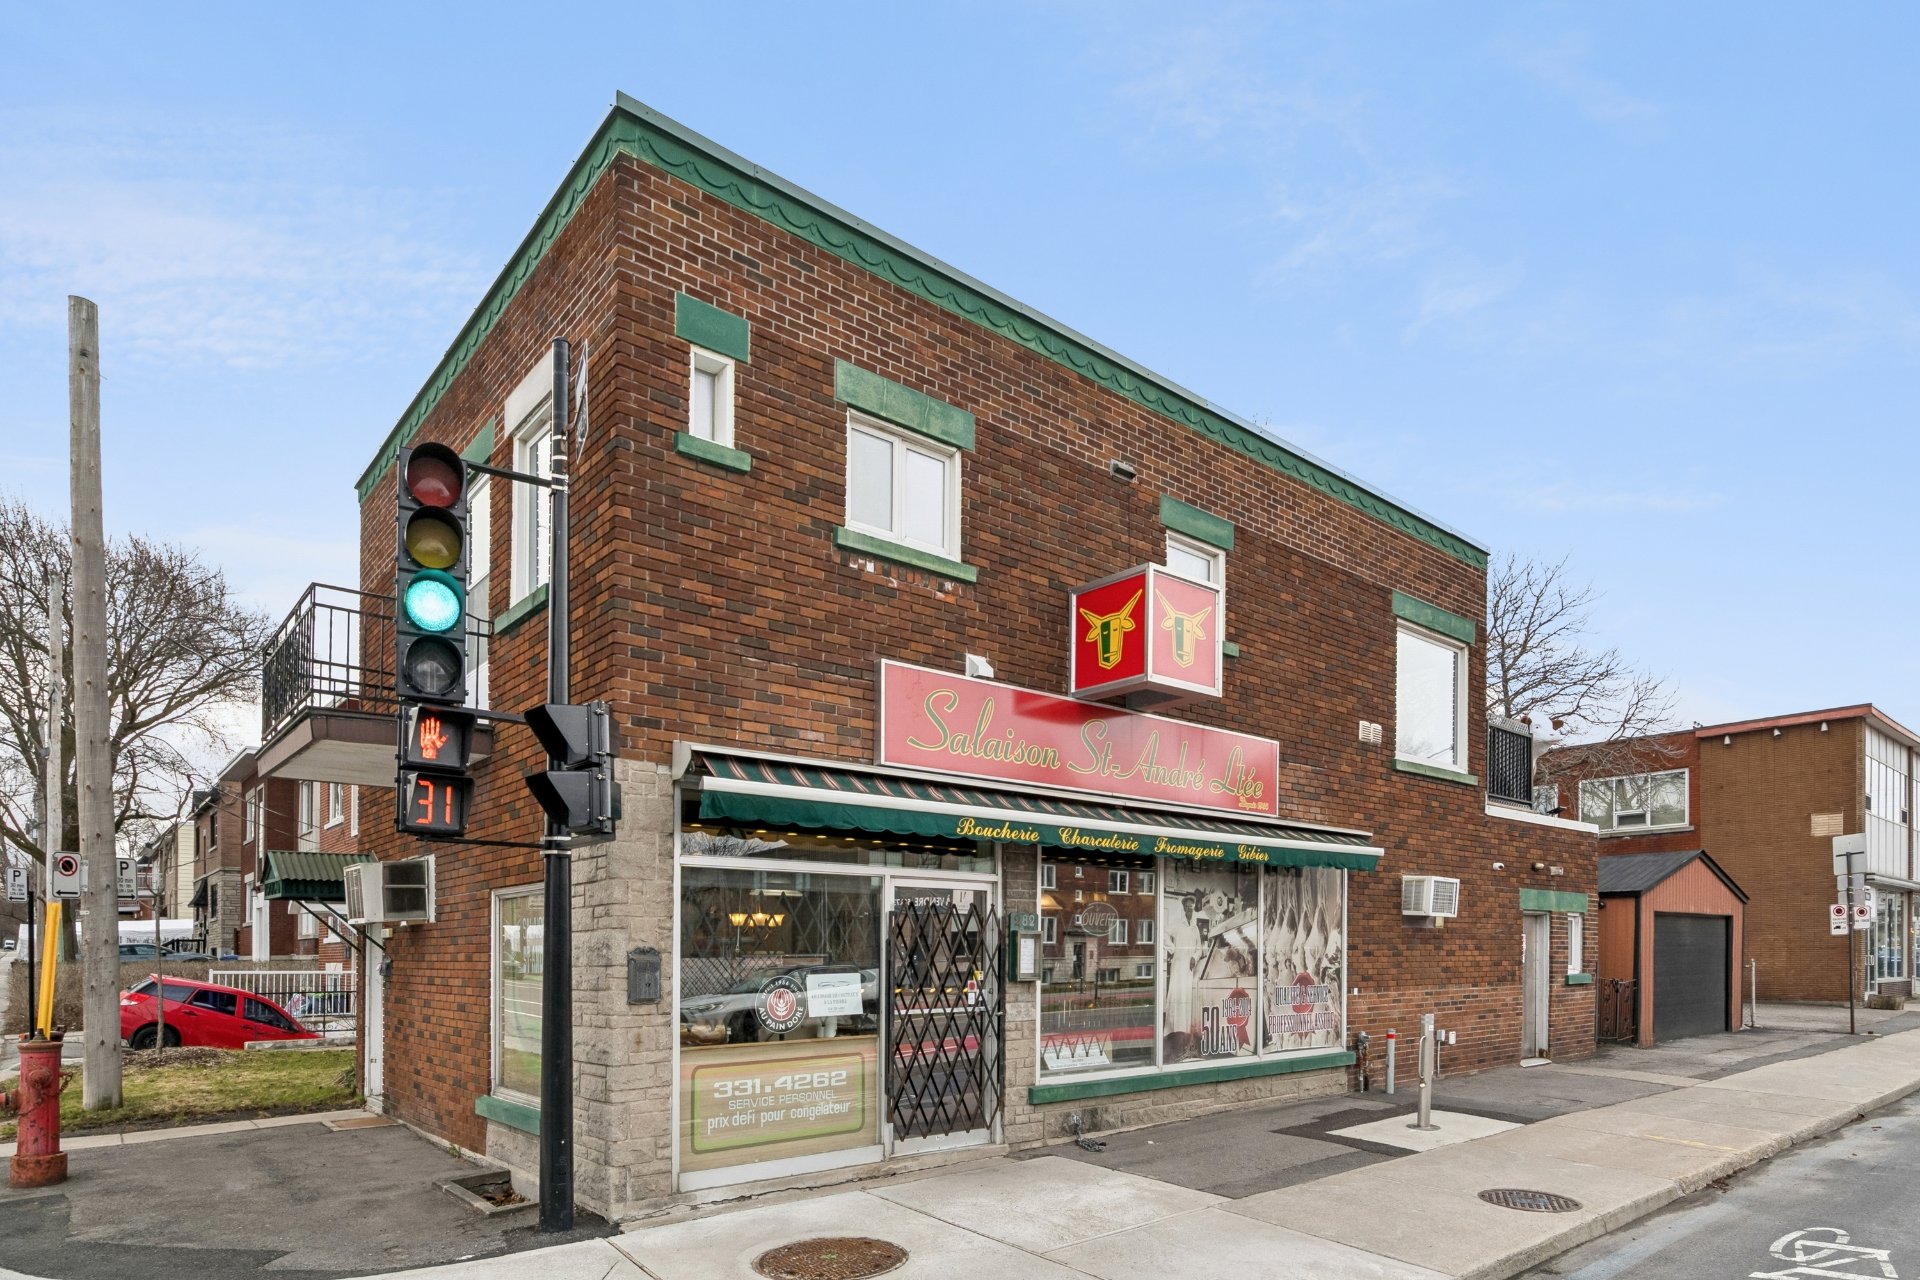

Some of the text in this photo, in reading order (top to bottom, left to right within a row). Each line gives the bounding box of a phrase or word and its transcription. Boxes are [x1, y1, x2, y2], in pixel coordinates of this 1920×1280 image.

[907, 689, 1263, 798] Salaison St-André Ltée
[415, 779, 452, 824] 31
[956, 817, 1270, 862] Boucherie Charcuterie Fromagerie Gibier
[13, 869, 21, 882] P
[120, 861, 129, 876] P
[1083, 912, 1116, 927] OUVERT
[759, 1007, 768, 1020] AU
[766, 1018, 786, 1030] PAIN
[1200, 1005, 1237, 1055] 50 ANS
[713, 1070, 847, 1098] 331.4262
[728, 1089, 838, 1110] SERVICE PERSONNEL
[707, 1101, 851, 1135] prix défi pour congélateur
